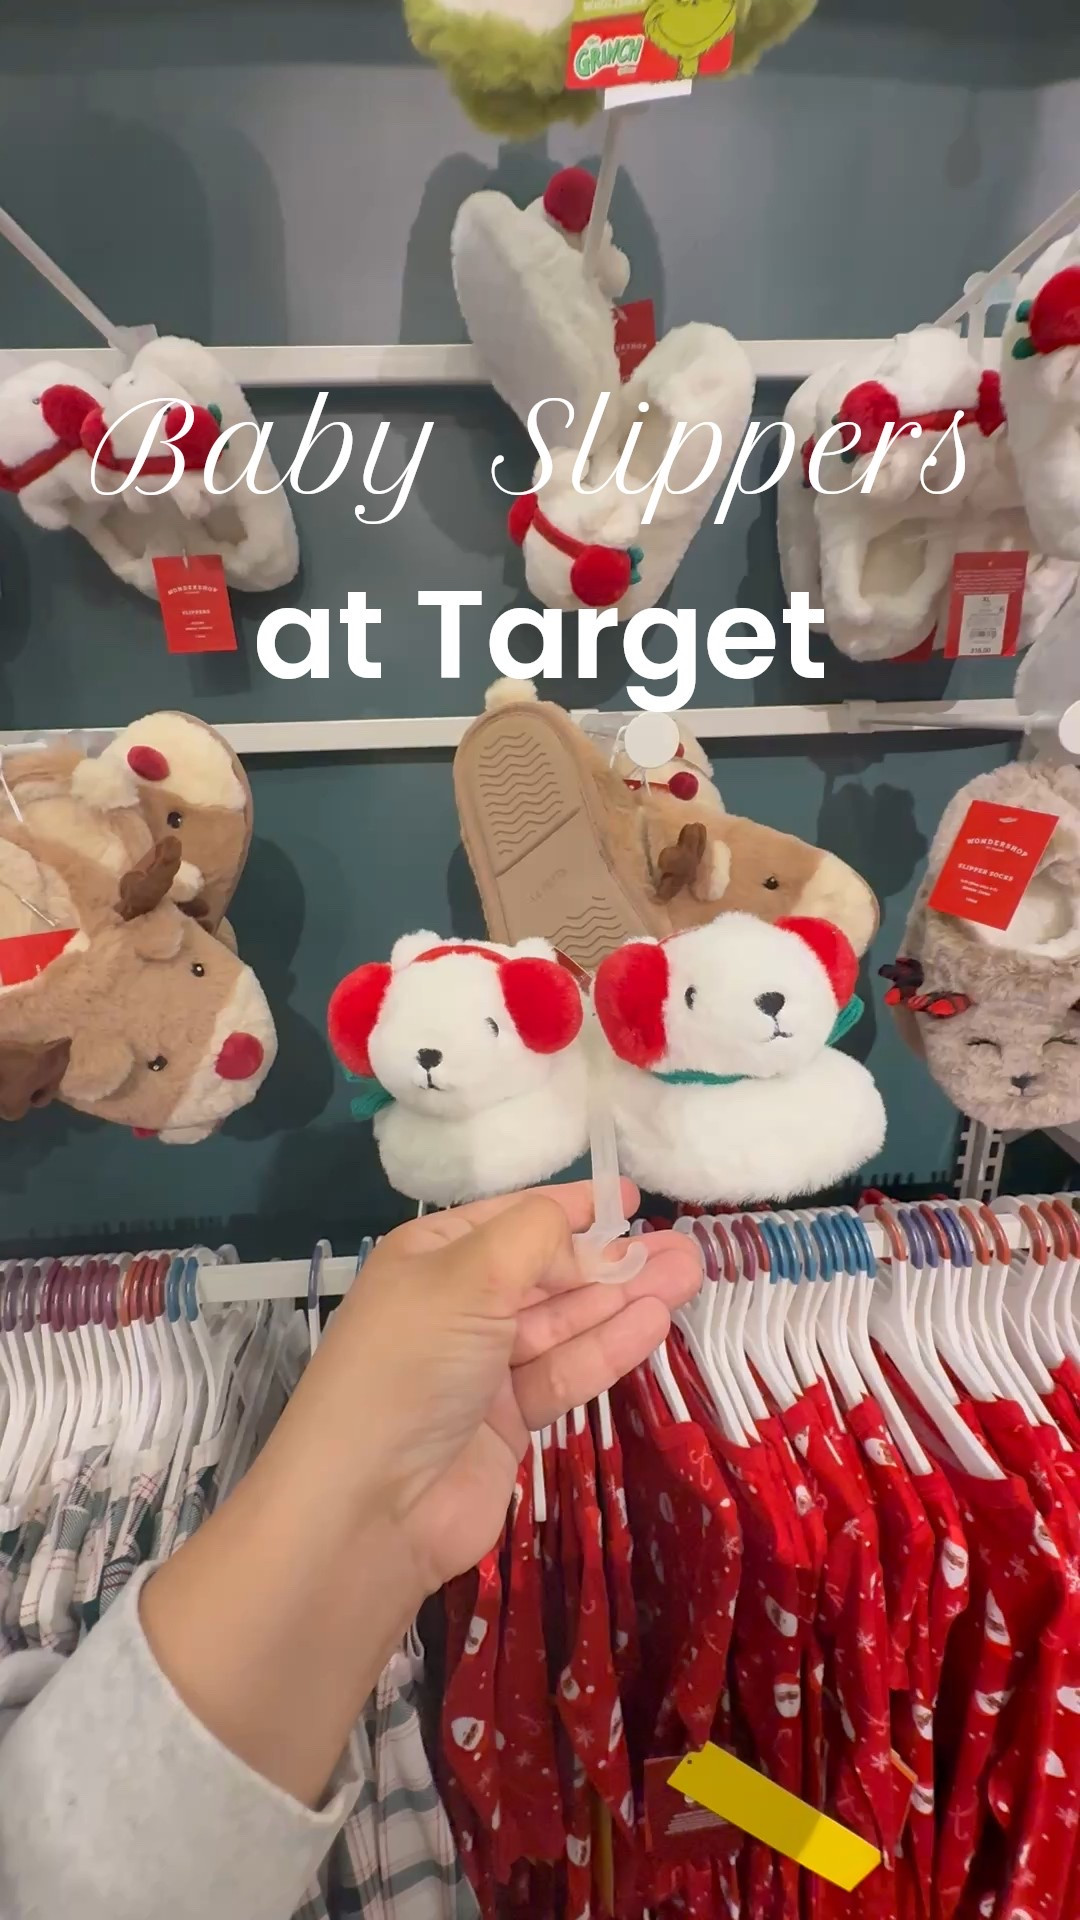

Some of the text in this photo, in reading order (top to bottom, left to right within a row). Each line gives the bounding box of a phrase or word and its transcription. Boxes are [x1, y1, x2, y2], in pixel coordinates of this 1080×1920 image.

[574, 36, 645, 79] GRINCH
[966, 837, 1029, 857] WONDERSHOP
[958, 862, 1014, 882] SLIPPER SOCKS
